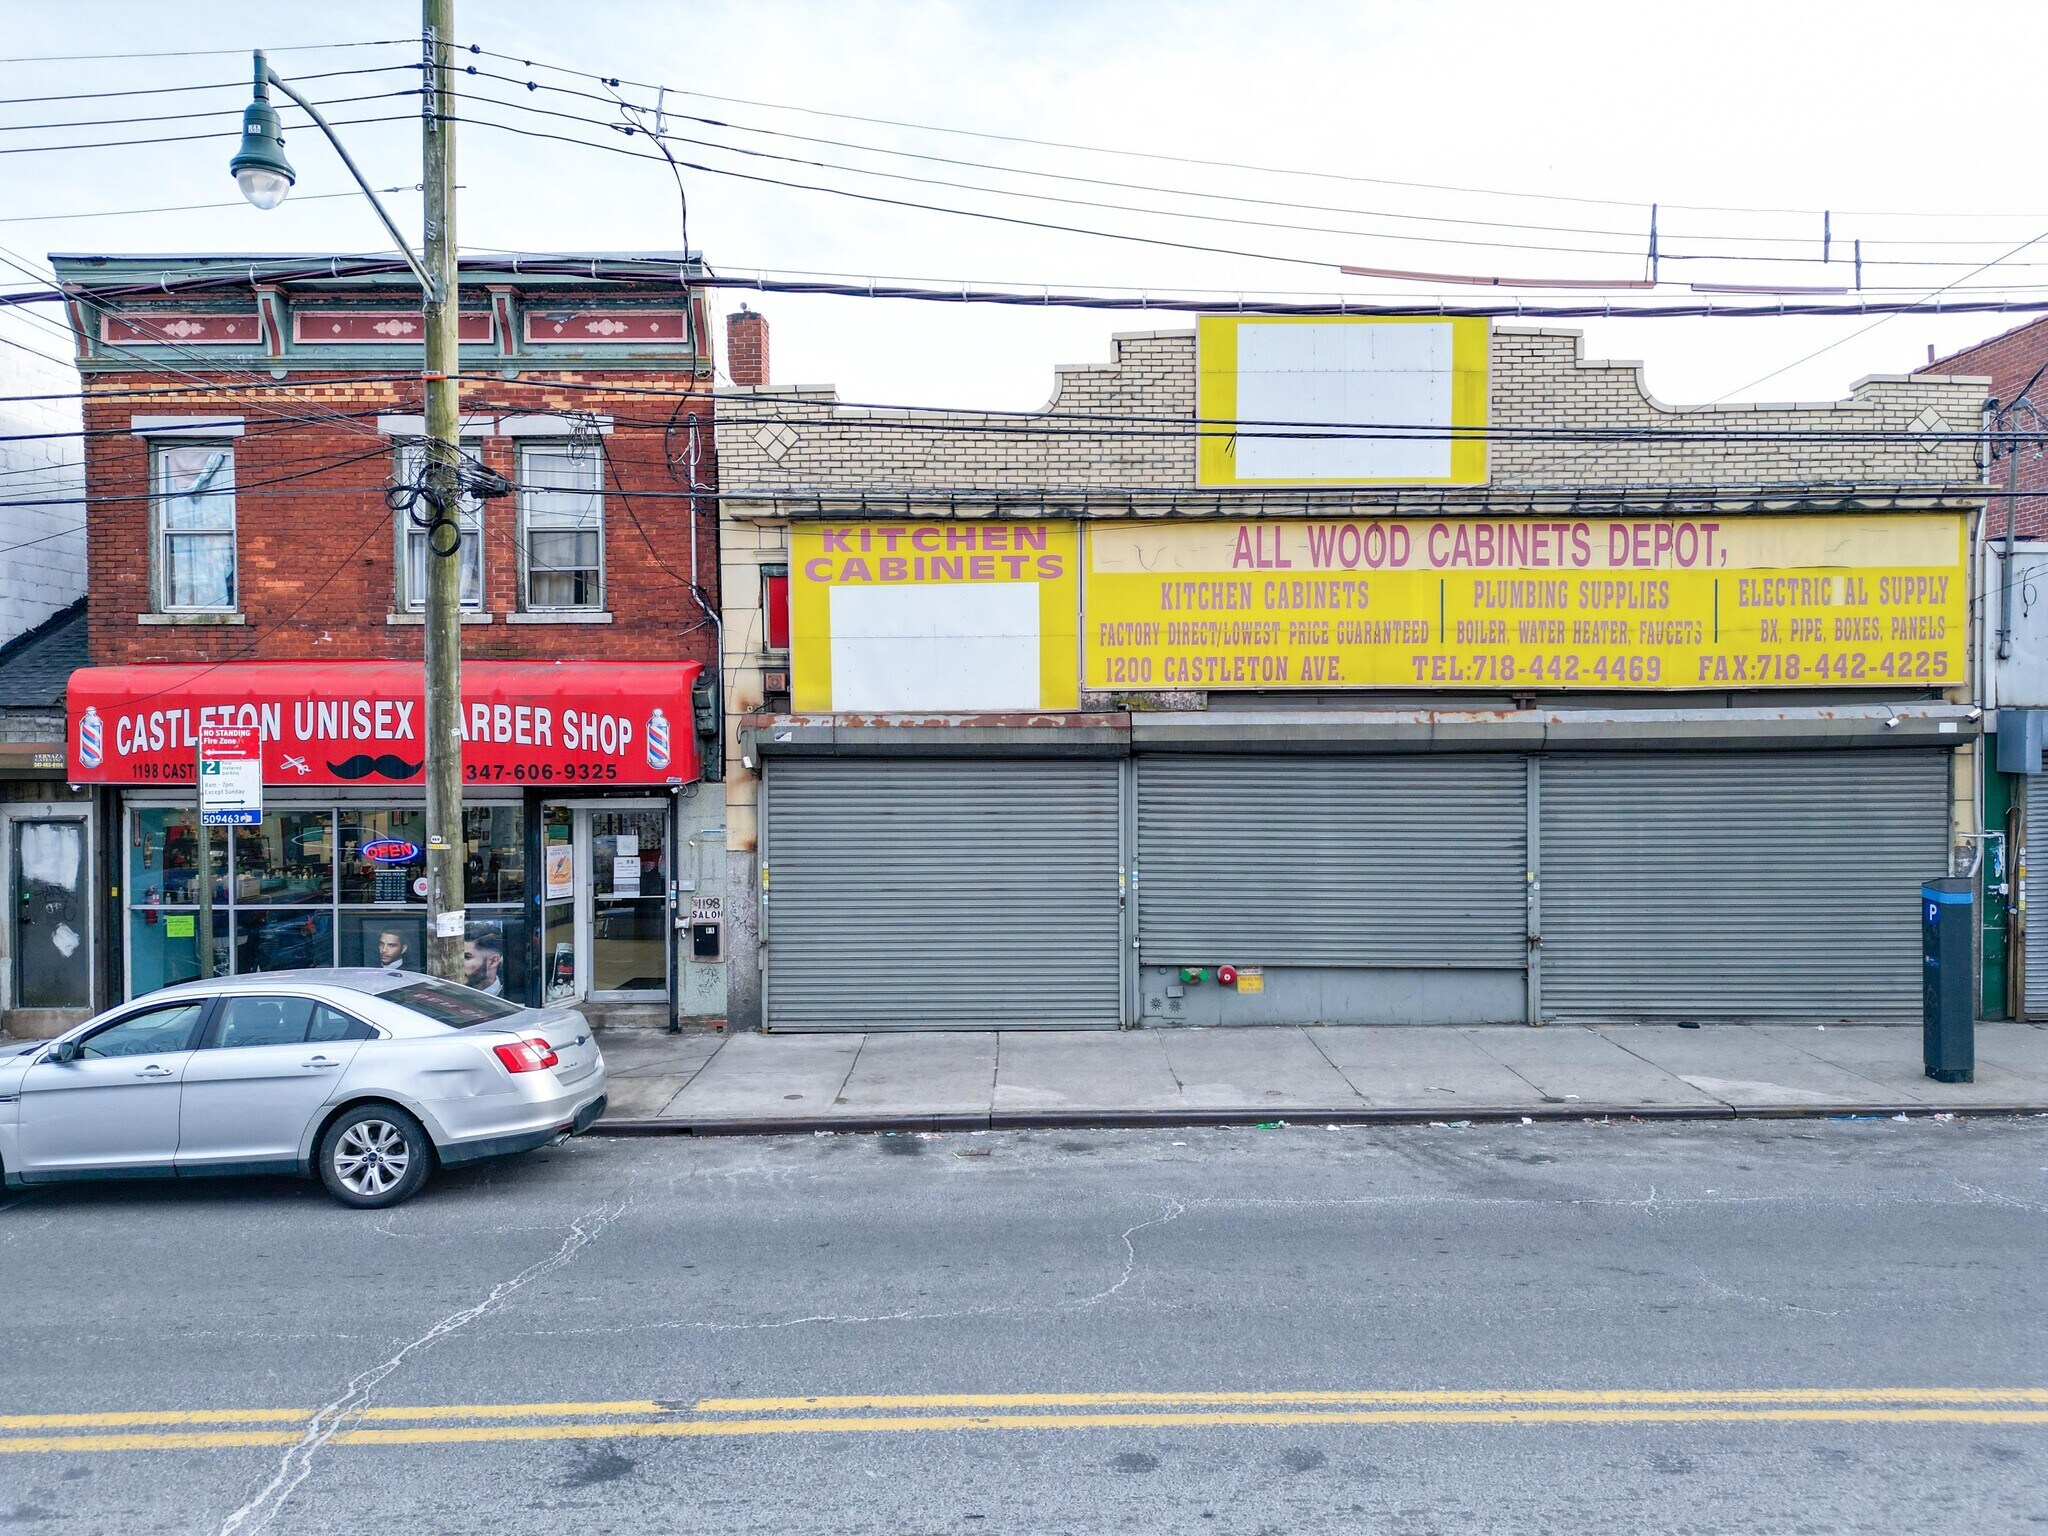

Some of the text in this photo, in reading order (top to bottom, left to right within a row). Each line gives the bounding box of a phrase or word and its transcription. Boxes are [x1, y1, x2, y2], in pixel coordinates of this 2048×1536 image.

[822, 526, 1047, 553] KITCHEN
[1233, 522, 1727, 569] ALL WOOD CABINETS DEPOT,
[804, 555, 1064, 583] CABINETS
[1161, 580, 1370, 611] KITCHEN CABINETS
[1473, 579, 1670, 609] PLUMBING SUPPLIES
[1879, 576, 1949, 605] SUPPLY
[1099, 621, 1160, 647] FACTORY
[1289, 620, 1330, 645] PRICE
[1336, 619, 1430, 645] GUARANTEED
[1518, 619, 1565, 644] WATER
[1572, 619, 1631, 646] HEATER,
[1760, 615, 1946, 645] BX, PIPE, BOXES, PANELS
[1106, 655, 1346, 683] 1200 CASTLETON AVE.
[116, 698, 633, 757] CASTLETON UNISEX ARBER SHOP
[203, 729, 251, 737] NO STANDING
[132, 763, 196, 779] 1198 CAST
[206, 761, 216, 774] 2
[466, 763, 618, 780] 347-606-9325
[203, 815, 240, 824] 509463
[366, 843, 413, 860] OPEN
[692, 910, 724, 919] SALON
[698, 897, 721, 910] 1198
[1929, 903, 1938, 921] P
